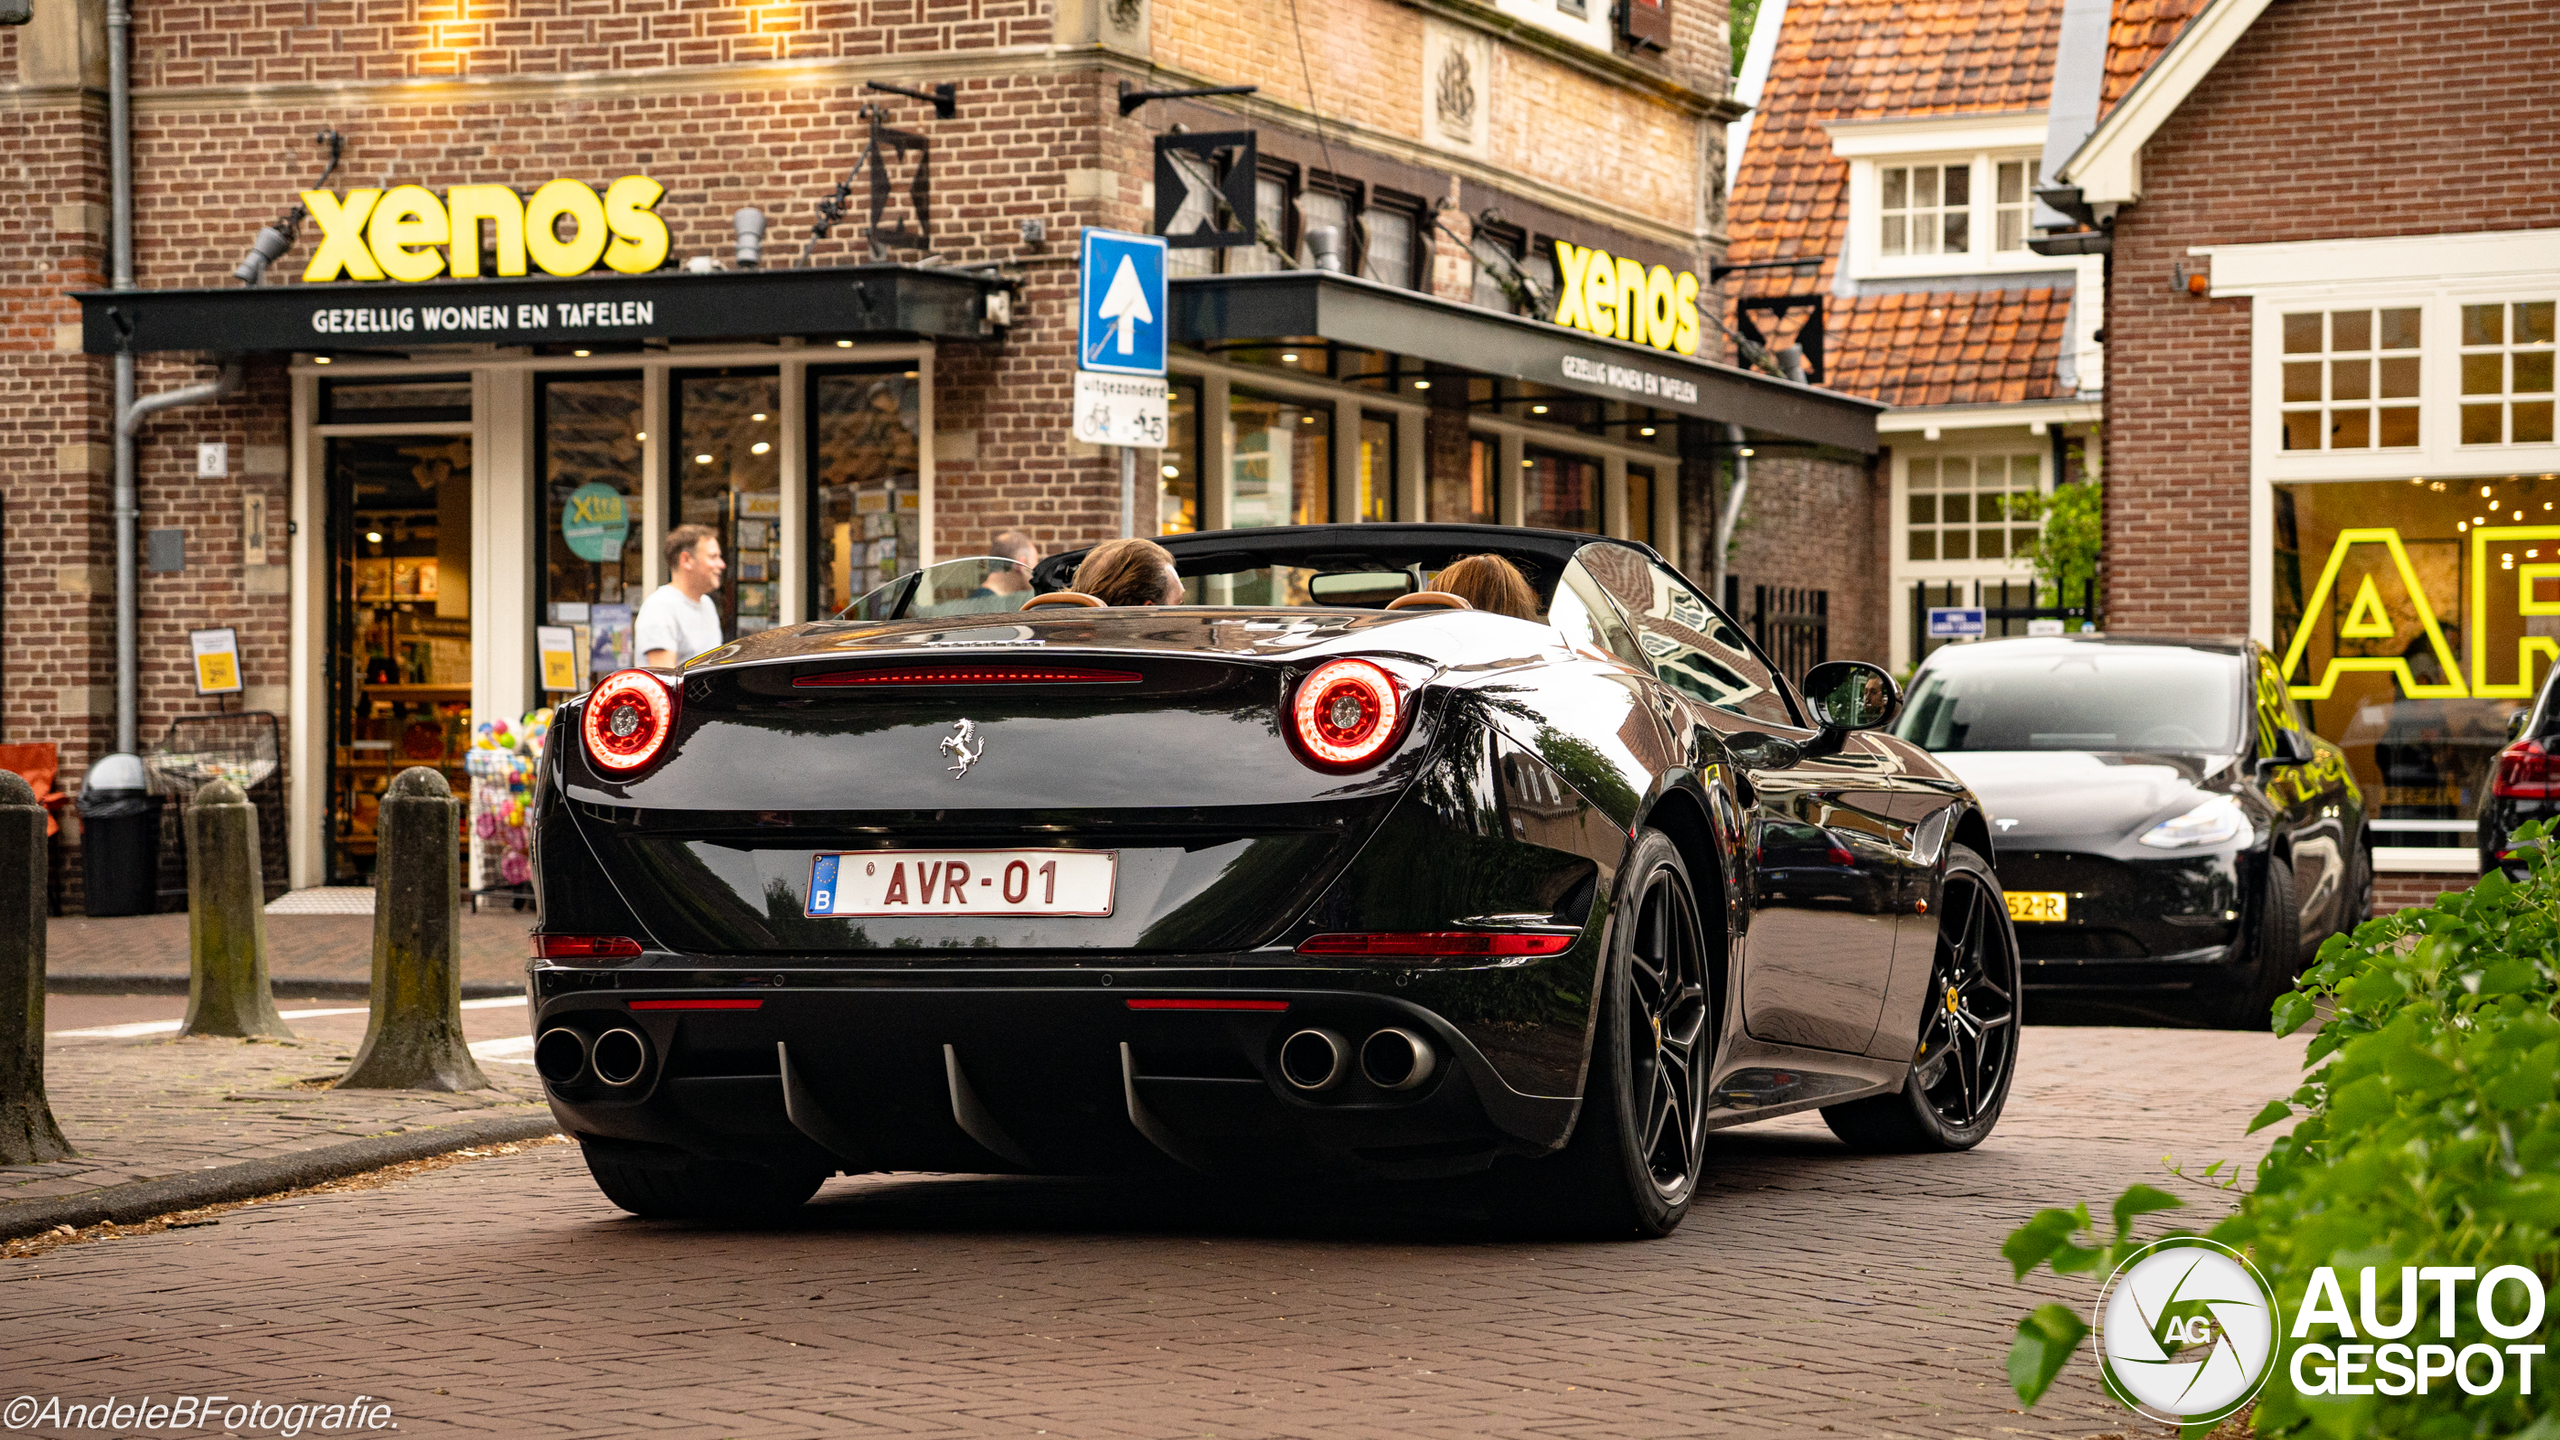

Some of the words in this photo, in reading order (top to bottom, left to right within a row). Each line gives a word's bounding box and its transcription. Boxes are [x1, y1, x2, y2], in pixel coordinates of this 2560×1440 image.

[300, 174, 671, 283] xenos
[312, 307, 415, 333] GEZELLIG
[421, 305, 509, 330] WONEN
[517, 304, 549, 328] EN
[556, 301, 654, 327] TAFELEN
[1554, 239, 1700, 356] xenos
[1083, 379, 1166, 399] uitgezonderd
[1561, 354, 1607, 385] GEZELLIG
[1607, 364, 1644, 392] WONEN
[1644, 372, 1659, 395] EN
[1659, 375, 1698, 405] TAFELEN
[814, 889, 831, 911] B
[883, 858, 1057, 905] AVR-01
